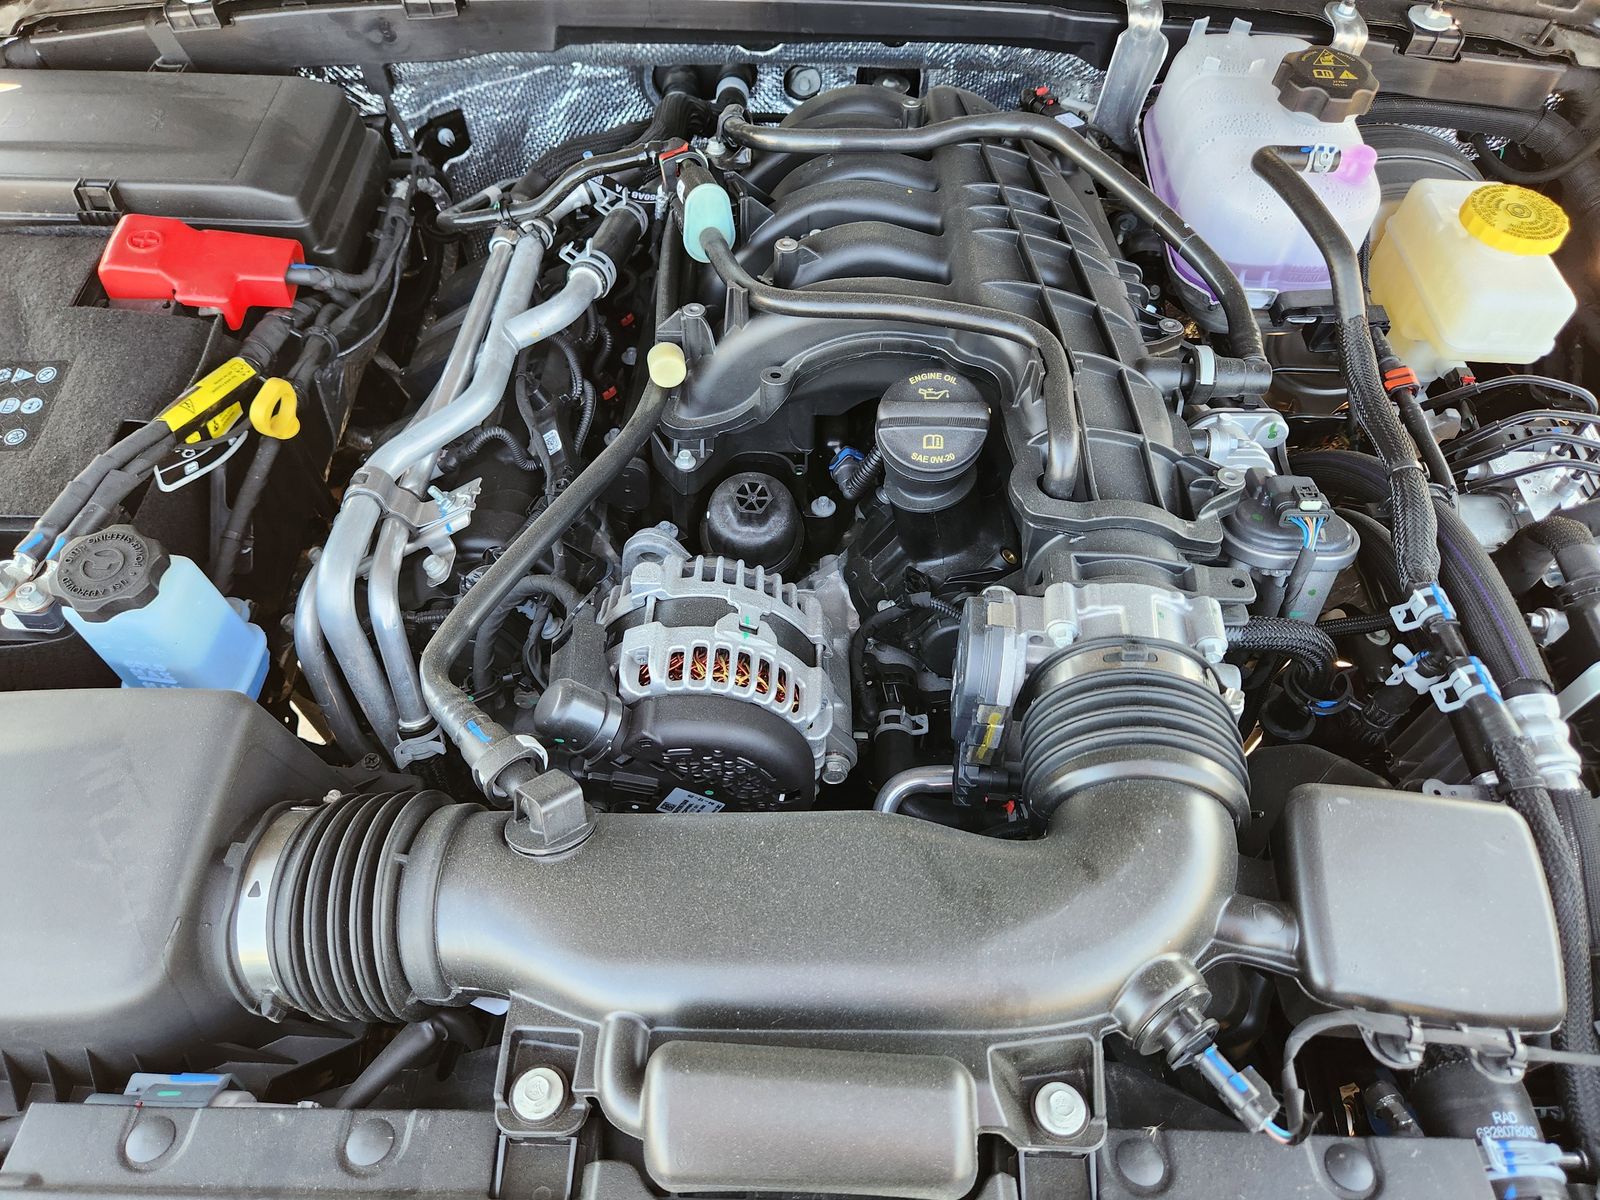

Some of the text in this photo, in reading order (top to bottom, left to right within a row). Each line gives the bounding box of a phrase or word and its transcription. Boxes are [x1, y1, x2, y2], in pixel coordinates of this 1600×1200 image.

[908, 372, 958, 385] ENGINE OIL
[911, 452, 955, 464] SAE 0W-20
[64, 533, 145, 568] POWER STEERING FLUID
[62, 576, 129, 597] USE APPROVED
[1492, 1111, 1518, 1124] RAD
